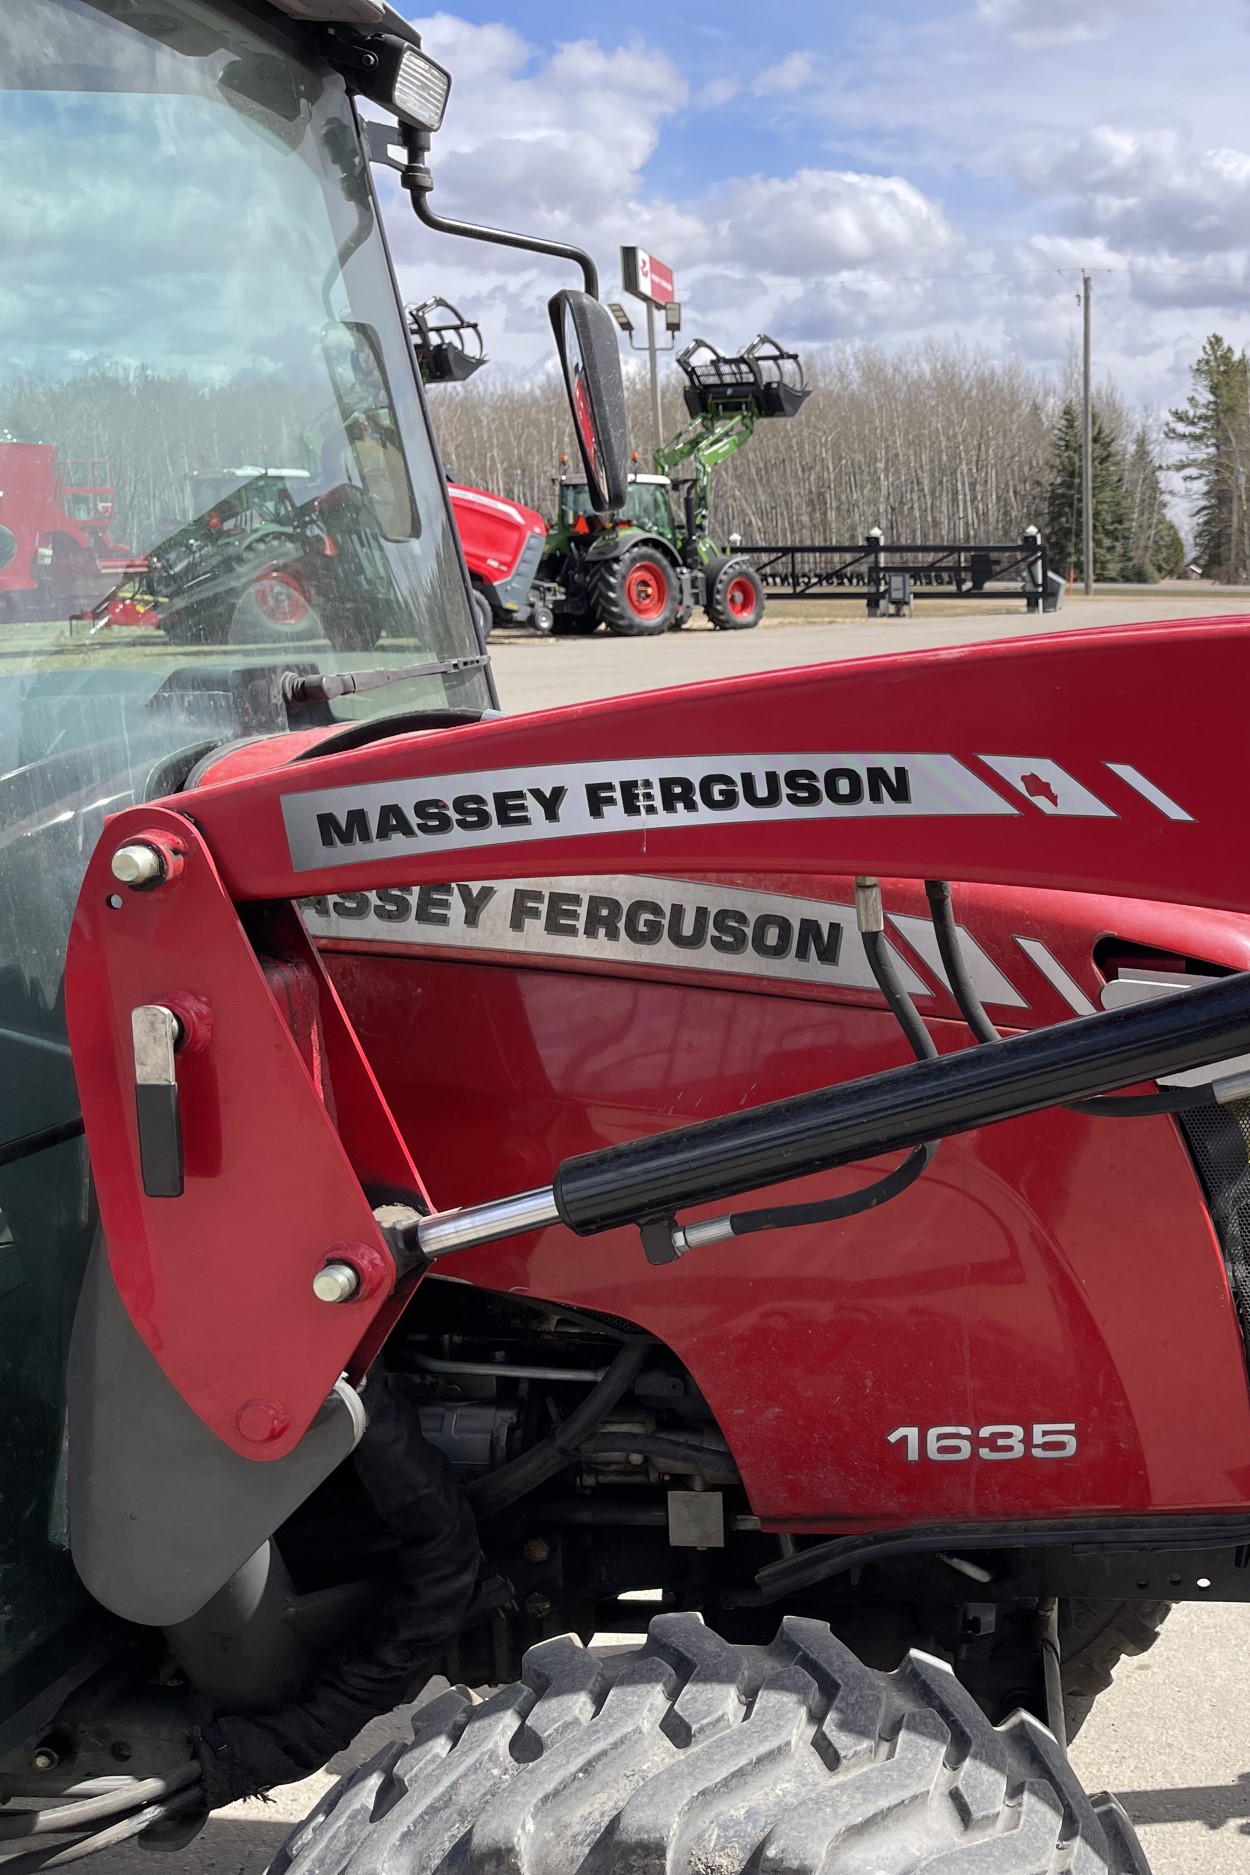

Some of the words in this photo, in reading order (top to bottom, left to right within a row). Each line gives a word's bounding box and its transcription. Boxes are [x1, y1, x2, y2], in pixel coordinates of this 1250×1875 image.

[316, 785, 567, 848] MASSEY
[586, 765, 911, 818] FERGUSON
[301, 882, 497, 928] SSEY
[508, 889, 845, 967] FERGUSON
[886, 1421, 1078, 1462] 1635
